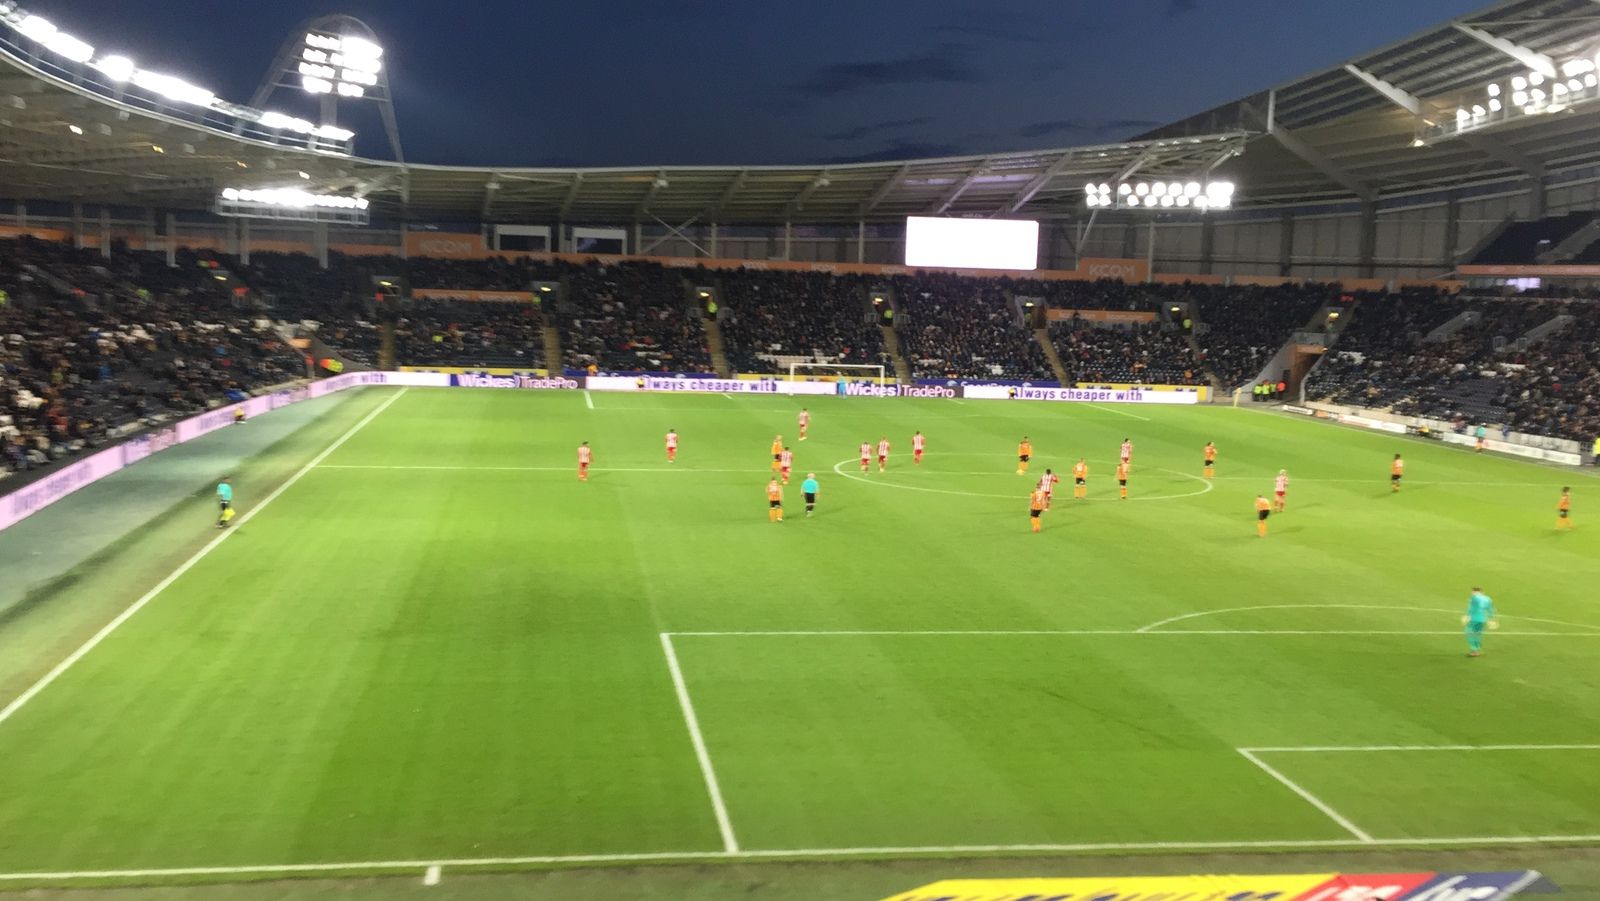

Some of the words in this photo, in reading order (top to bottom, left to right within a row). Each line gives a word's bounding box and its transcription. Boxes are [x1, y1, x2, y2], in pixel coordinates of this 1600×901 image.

[1089, 264, 1136, 277] KCOM
[458, 374, 515, 388] Wickes
[520, 376, 578, 389] TradePro
[690, 379, 744, 392] cheaper
[750, 381, 777, 391] with
[846, 383, 897, 396] Wickes
[902, 385, 955, 398] TradePro
[1060, 389, 1111, 401] cheaper
[1116, 390, 1143, 401] with
